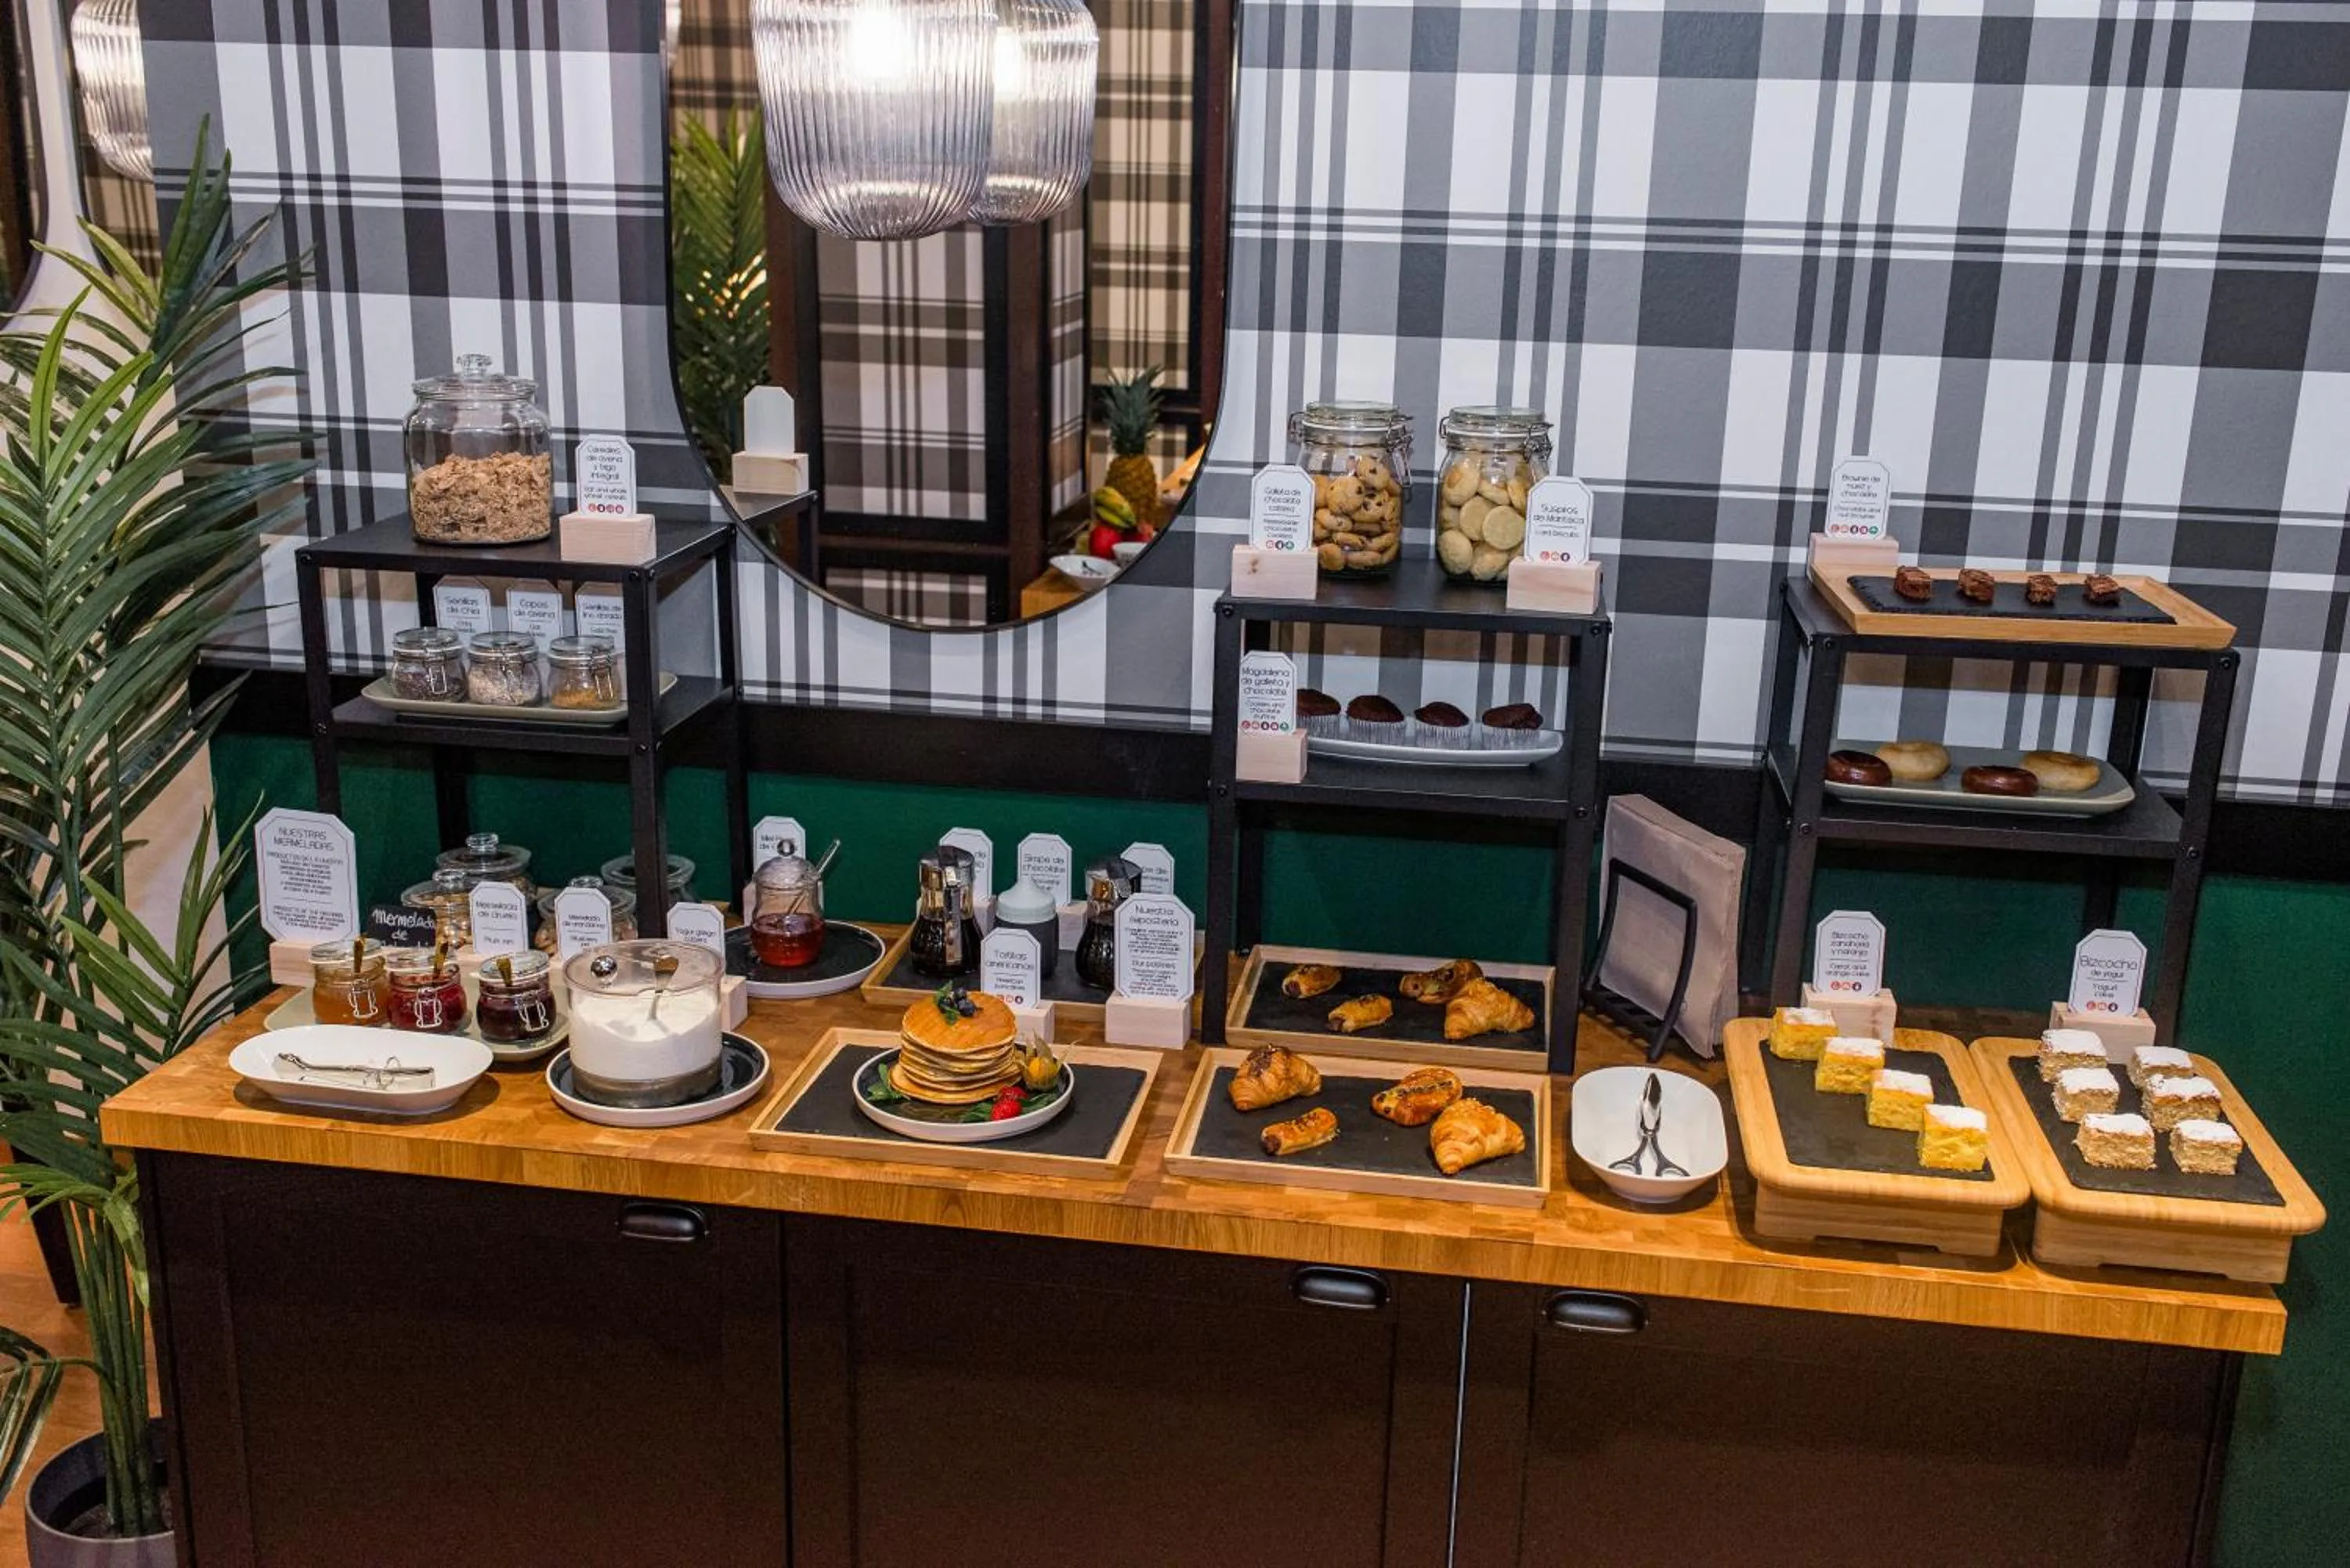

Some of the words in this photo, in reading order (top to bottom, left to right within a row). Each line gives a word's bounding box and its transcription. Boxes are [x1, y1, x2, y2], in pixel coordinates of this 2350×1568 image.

[278, 826, 327, 840] NUESTRAS
[274, 836, 335, 852] MERMELADAS
[1134, 905, 1175, 916] Nuestra
[392, 929, 407, 940] de
[2080, 955, 2138, 970] Bizcocho
